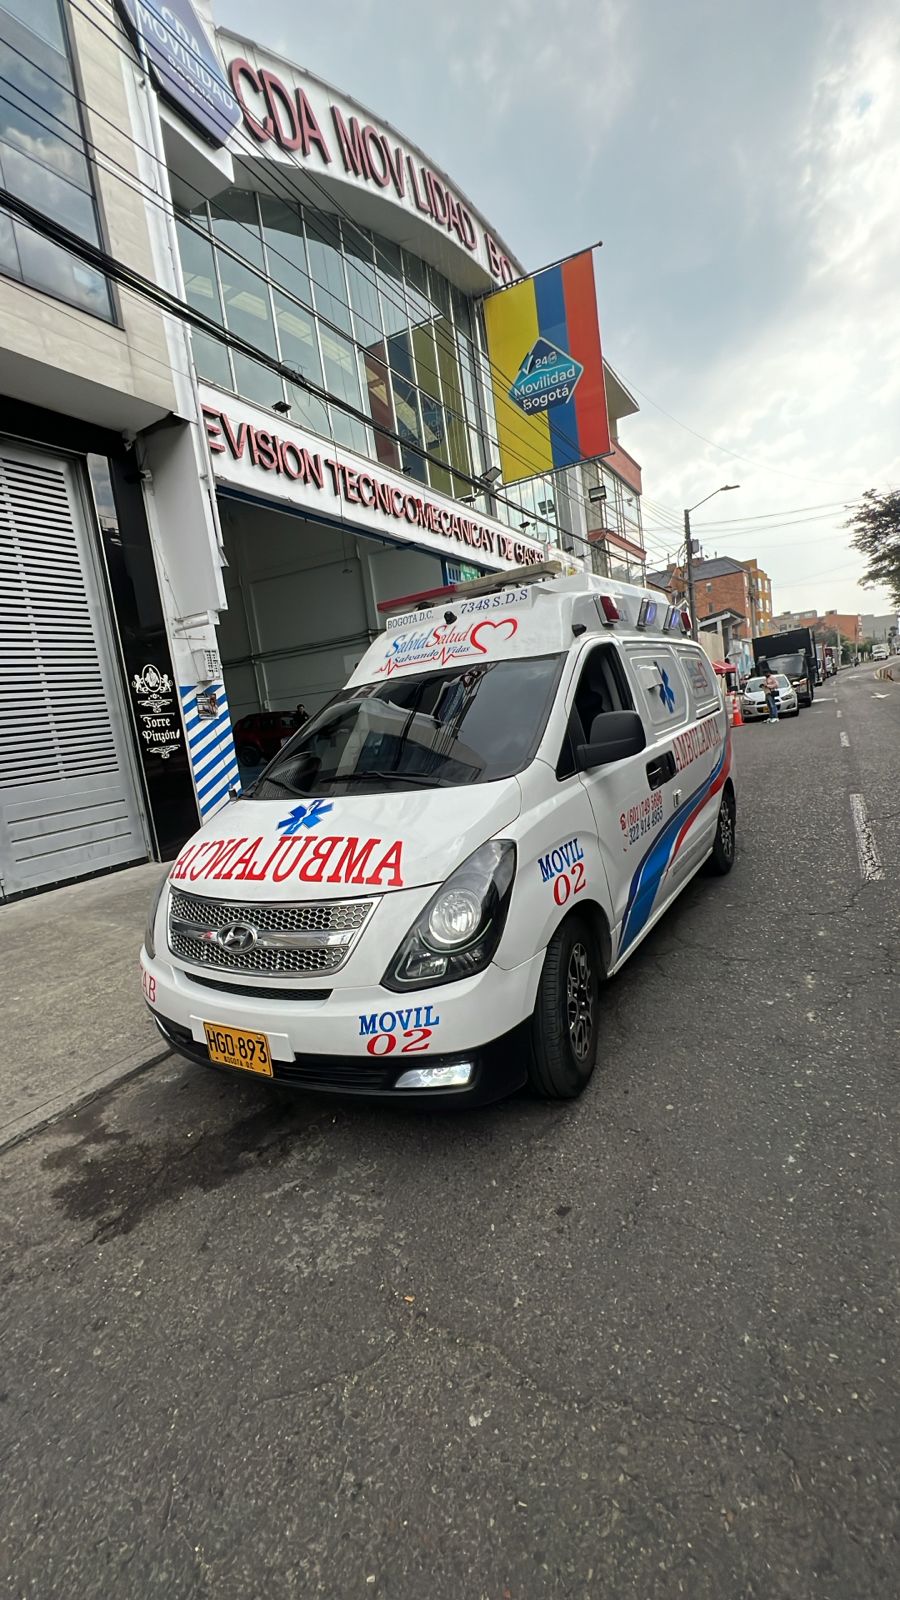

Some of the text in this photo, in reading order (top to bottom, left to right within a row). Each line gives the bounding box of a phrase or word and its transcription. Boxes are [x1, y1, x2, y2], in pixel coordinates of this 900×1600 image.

[160, 6, 203, 61] CDA
[138, 3, 234, 110] MOVILIDAD
[228, 57, 331, 164] CDA
[331, 105, 477, 250] MOVLIDAD
[514, 363, 576, 397] Movilidad
[523, 384, 569, 411] Bogotá
[200, 403, 324, 489] EVISION
[387, 614, 418, 630] BOGOTA
[460, 598, 491, 615] 7348
[392, 649, 439, 664] Salvando
[142, 716, 171, 729] Torre
[672, 716, 722, 773] AMBULANCIA
[537, 838, 584, 882] MOVIL
[553, 861, 587, 906] 02
[359, 1005, 440, 1036] MOVIL
[366, 1029, 433, 1056] 02
